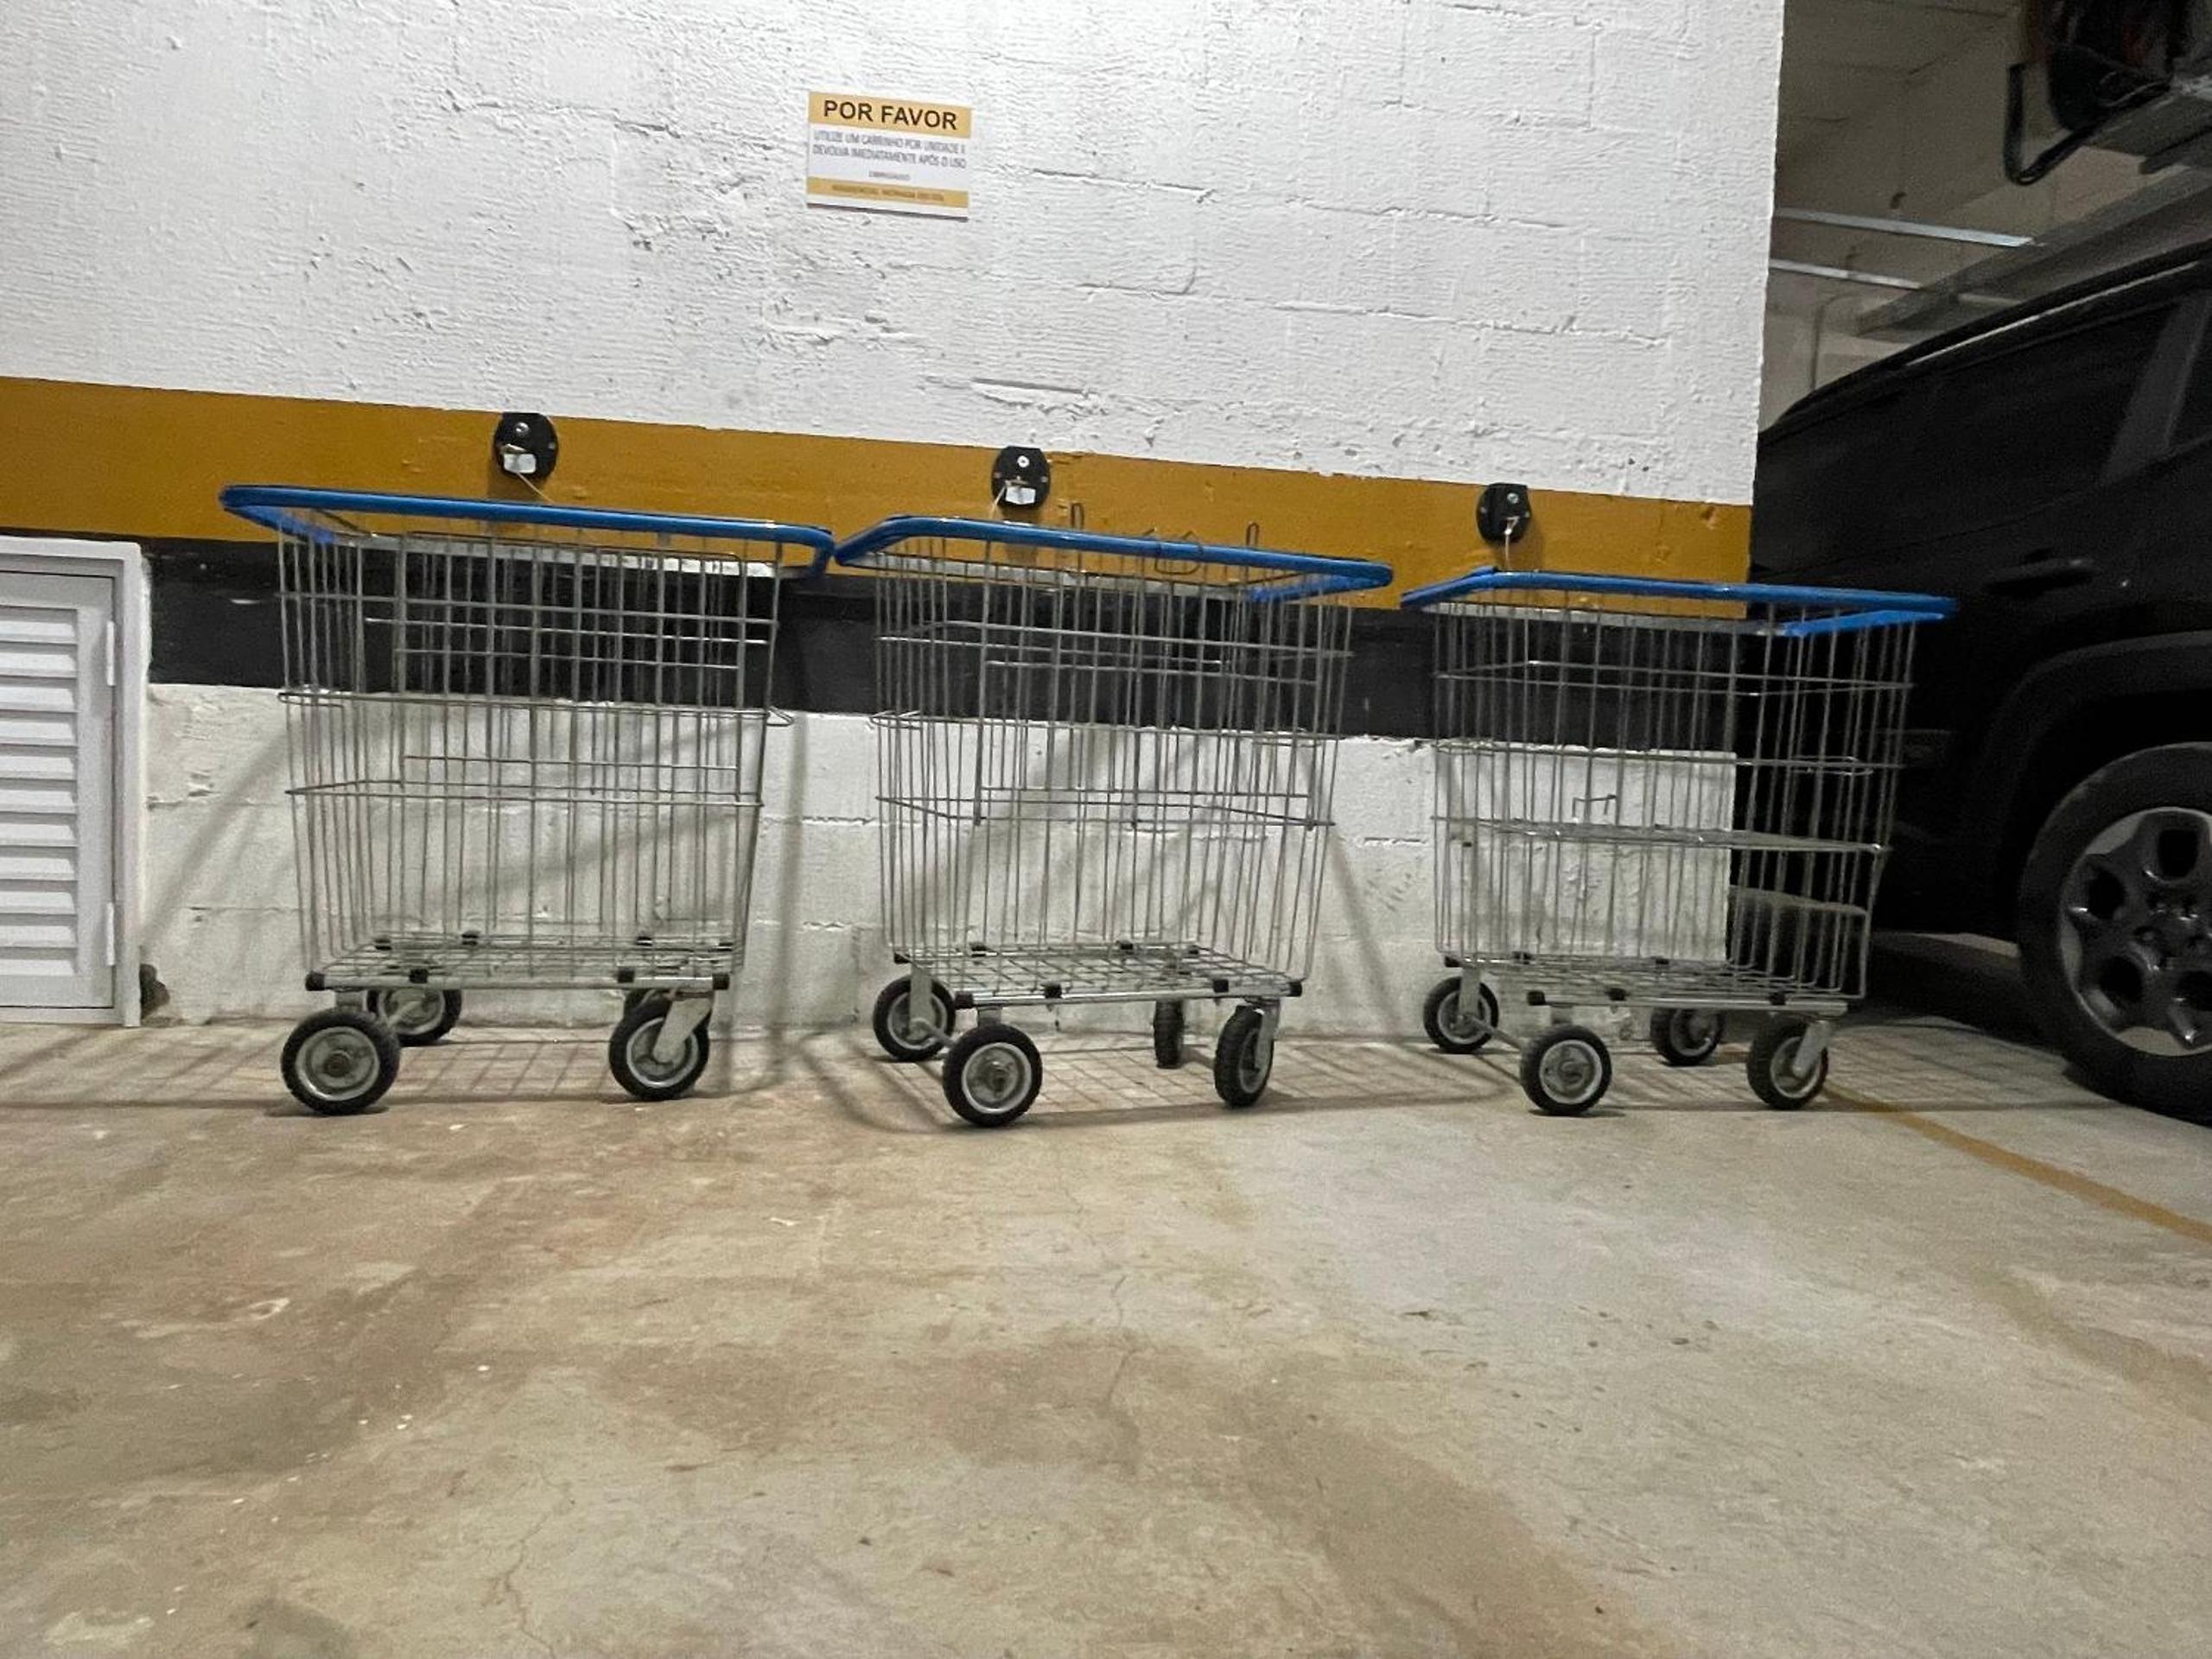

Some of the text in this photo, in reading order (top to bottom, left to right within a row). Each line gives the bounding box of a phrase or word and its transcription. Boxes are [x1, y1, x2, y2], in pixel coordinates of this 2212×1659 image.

[823, 99, 957, 130] POR FAVOR
[846, 133, 860, 144] UM
[861, 134, 903, 148] CARRINHO
[905, 139, 921, 149] POR
[813, 144, 967, 169] DEVOLVA IMEDIATAMENTE APÓS O USO
